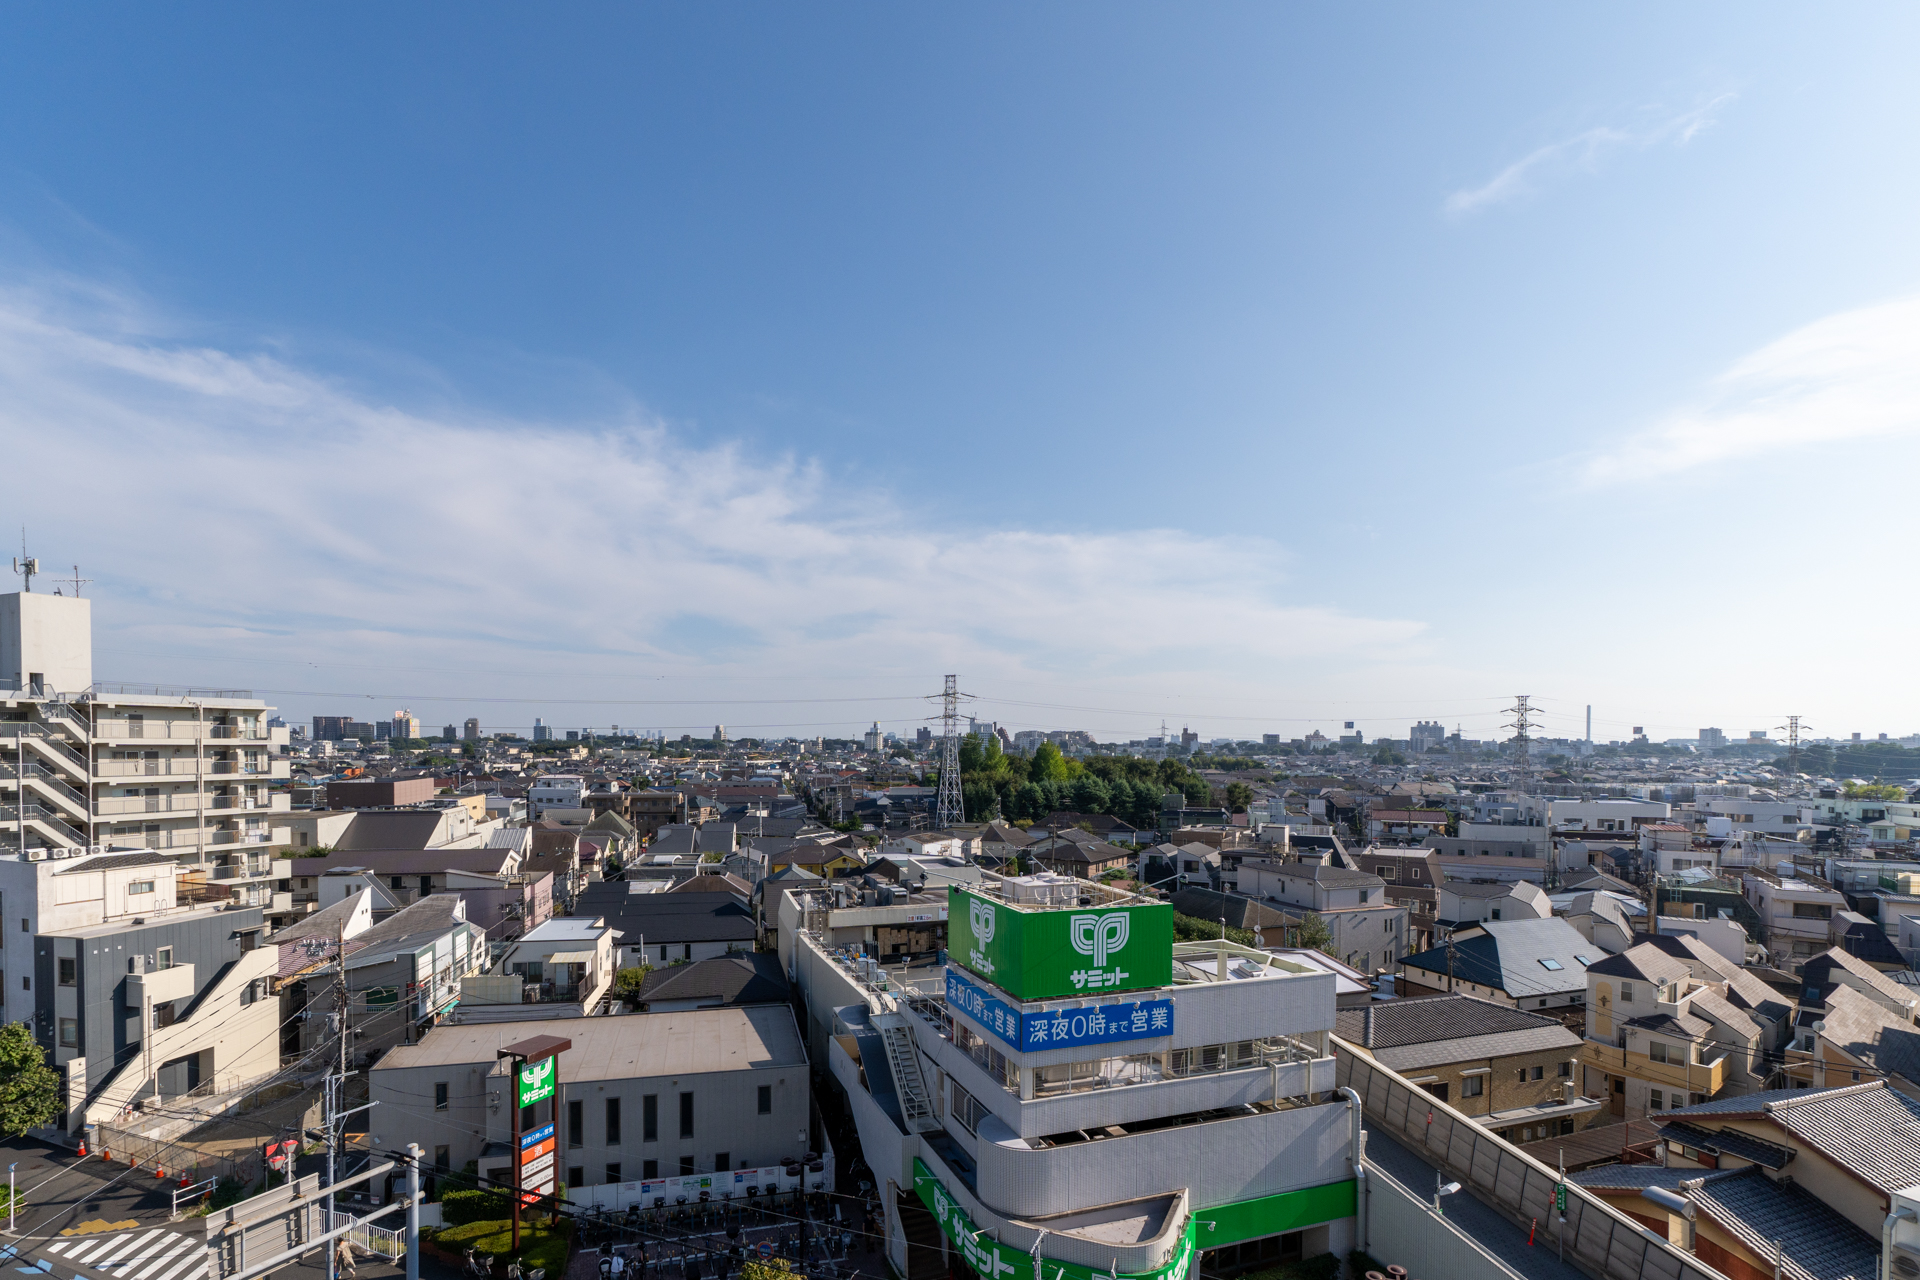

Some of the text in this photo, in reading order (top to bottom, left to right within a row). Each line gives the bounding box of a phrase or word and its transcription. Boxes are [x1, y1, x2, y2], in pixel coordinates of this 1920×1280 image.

[969, 948, 995, 975] サミット
[1070, 967, 1129, 989] サミット
[1029, 1007, 1168, 1043] 深夜0時まで営業
[522, 1084, 552, 1103] サミット
[534, 1144, 543, 1158] 酒
[953, 1213, 1015, 1280] サミット
